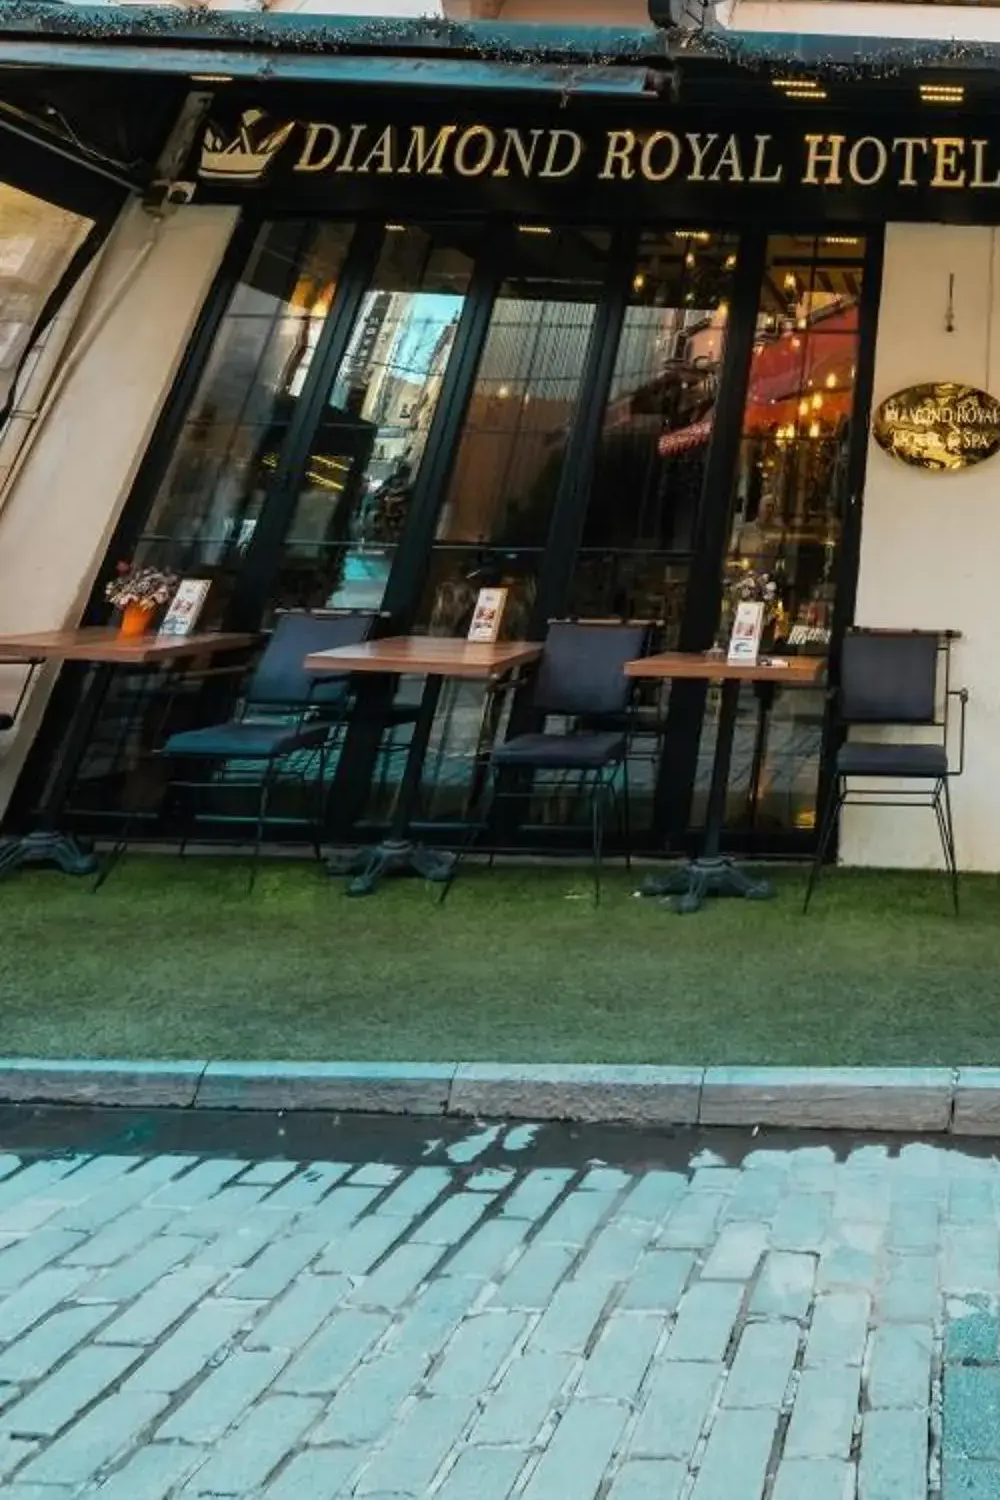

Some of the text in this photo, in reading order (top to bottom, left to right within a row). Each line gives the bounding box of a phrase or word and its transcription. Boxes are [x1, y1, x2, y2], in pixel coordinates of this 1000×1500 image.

[293, 122, 584, 179] DIAMOND
[599, 129, 785, 184] ROYAL
[963, 428, 990, 449] SPA
